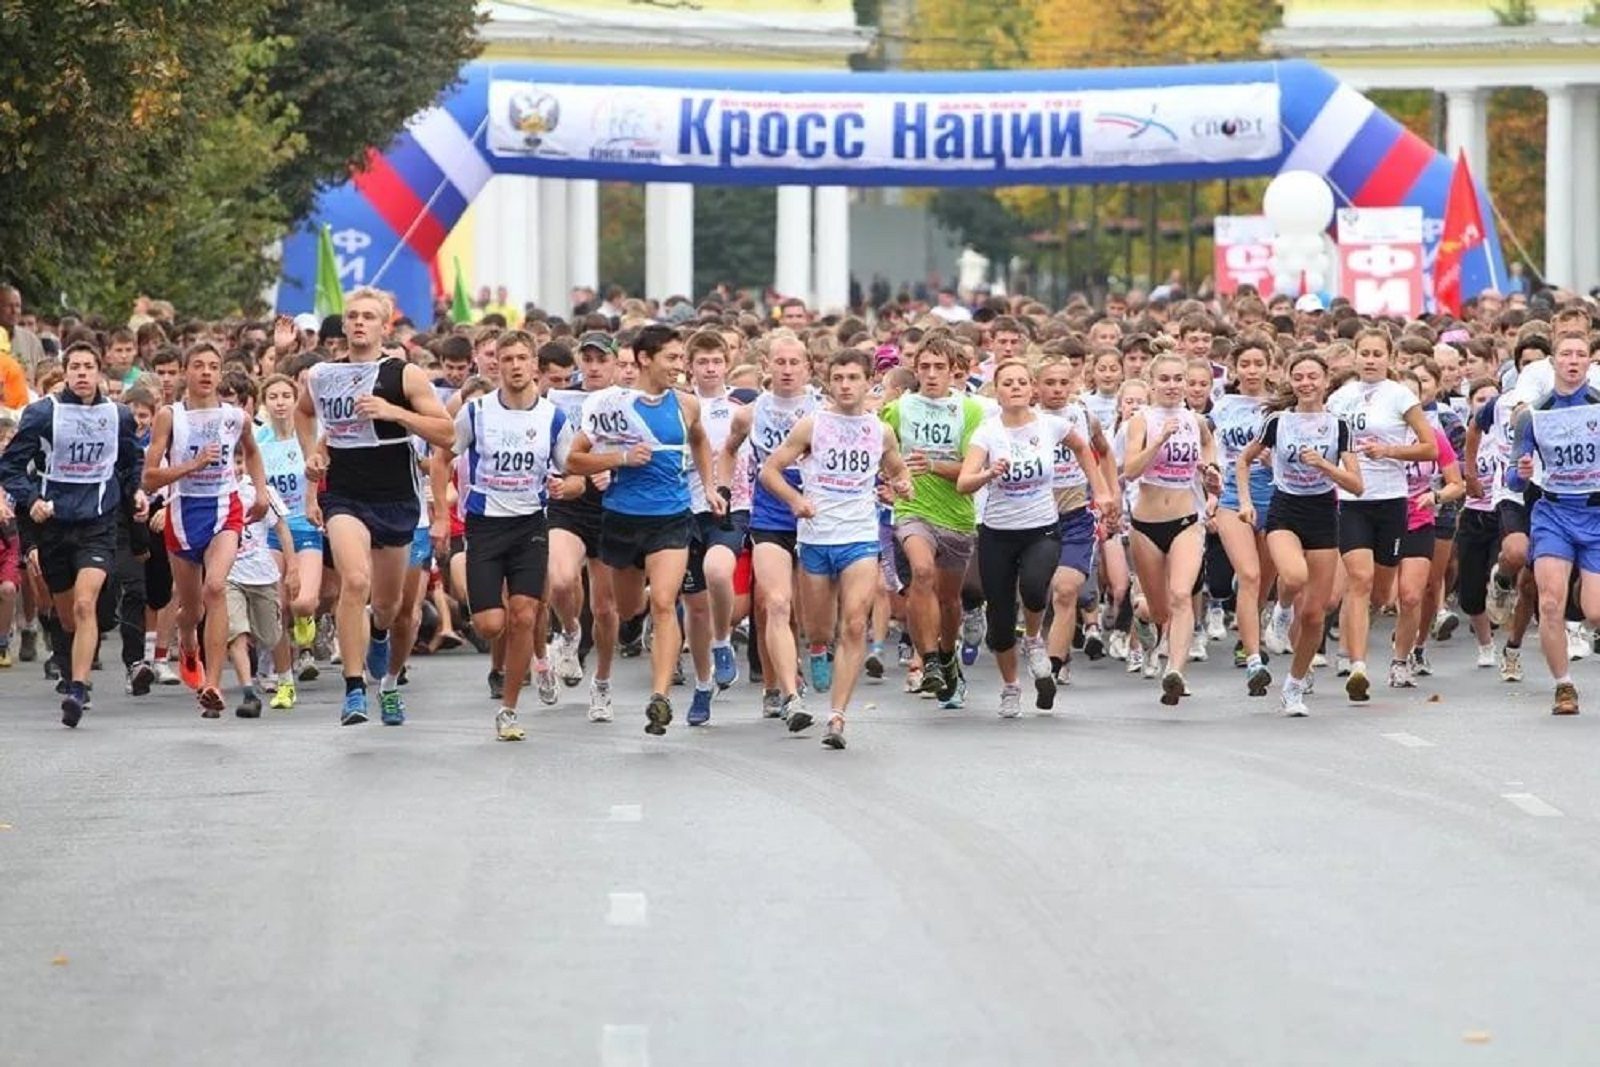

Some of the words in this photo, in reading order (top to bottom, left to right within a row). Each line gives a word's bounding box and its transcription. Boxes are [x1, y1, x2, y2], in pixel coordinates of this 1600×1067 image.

[677, 97, 865, 168] Кросс
[893, 101, 1083, 169] Нации
[589, 410, 628, 433] 2013
[911, 421, 953, 444] 7162
[68, 441, 105, 463] 1177
[492, 450, 534, 472] 1209
[826, 448, 870, 473] 3189
[1164, 442, 1198, 462] 1526
[1554, 443, 1595, 467] 3183
